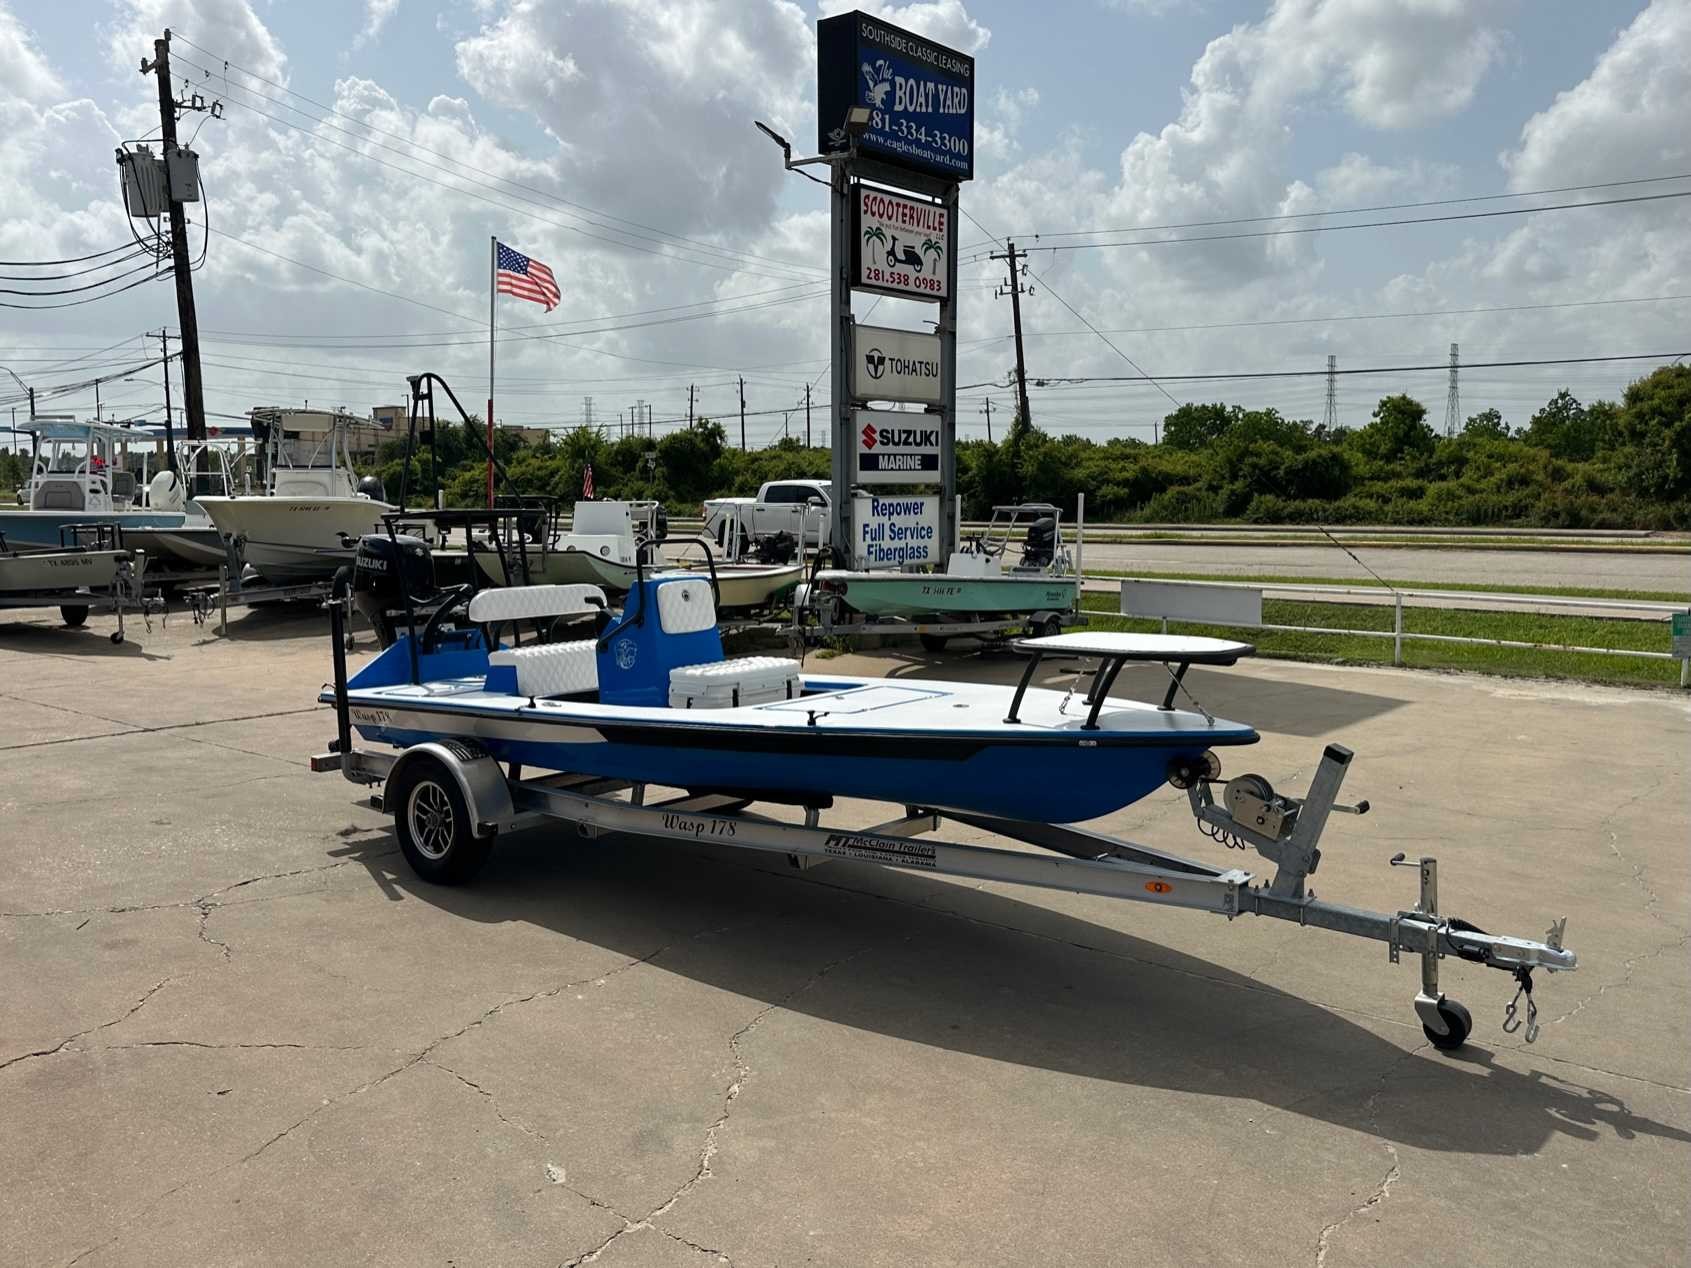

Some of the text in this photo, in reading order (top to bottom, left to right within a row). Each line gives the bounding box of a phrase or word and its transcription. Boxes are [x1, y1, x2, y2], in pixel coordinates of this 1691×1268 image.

[862, 23, 970, 77] SOUTHSIDE CLASSIC LEASING
[875, 59, 894, 80] The
[894, 75, 968, 114] BOAT YARD
[868, 110, 968, 156] 81-334-3300
[863, 194, 945, 233] SCOOTERVILLE
[866, 266, 942, 292] 281.538 0983
[888, 357, 939, 378] TOHATSU
[879, 428, 939, 447] SUZUKI
[878, 455, 922, 470] MARINE
[872, 498, 924, 520] Repower
[863, 521, 933, 542] Full Service
[867, 543, 928, 565] Fiberglass
[662, 813, 737, 837] Wasp 178
